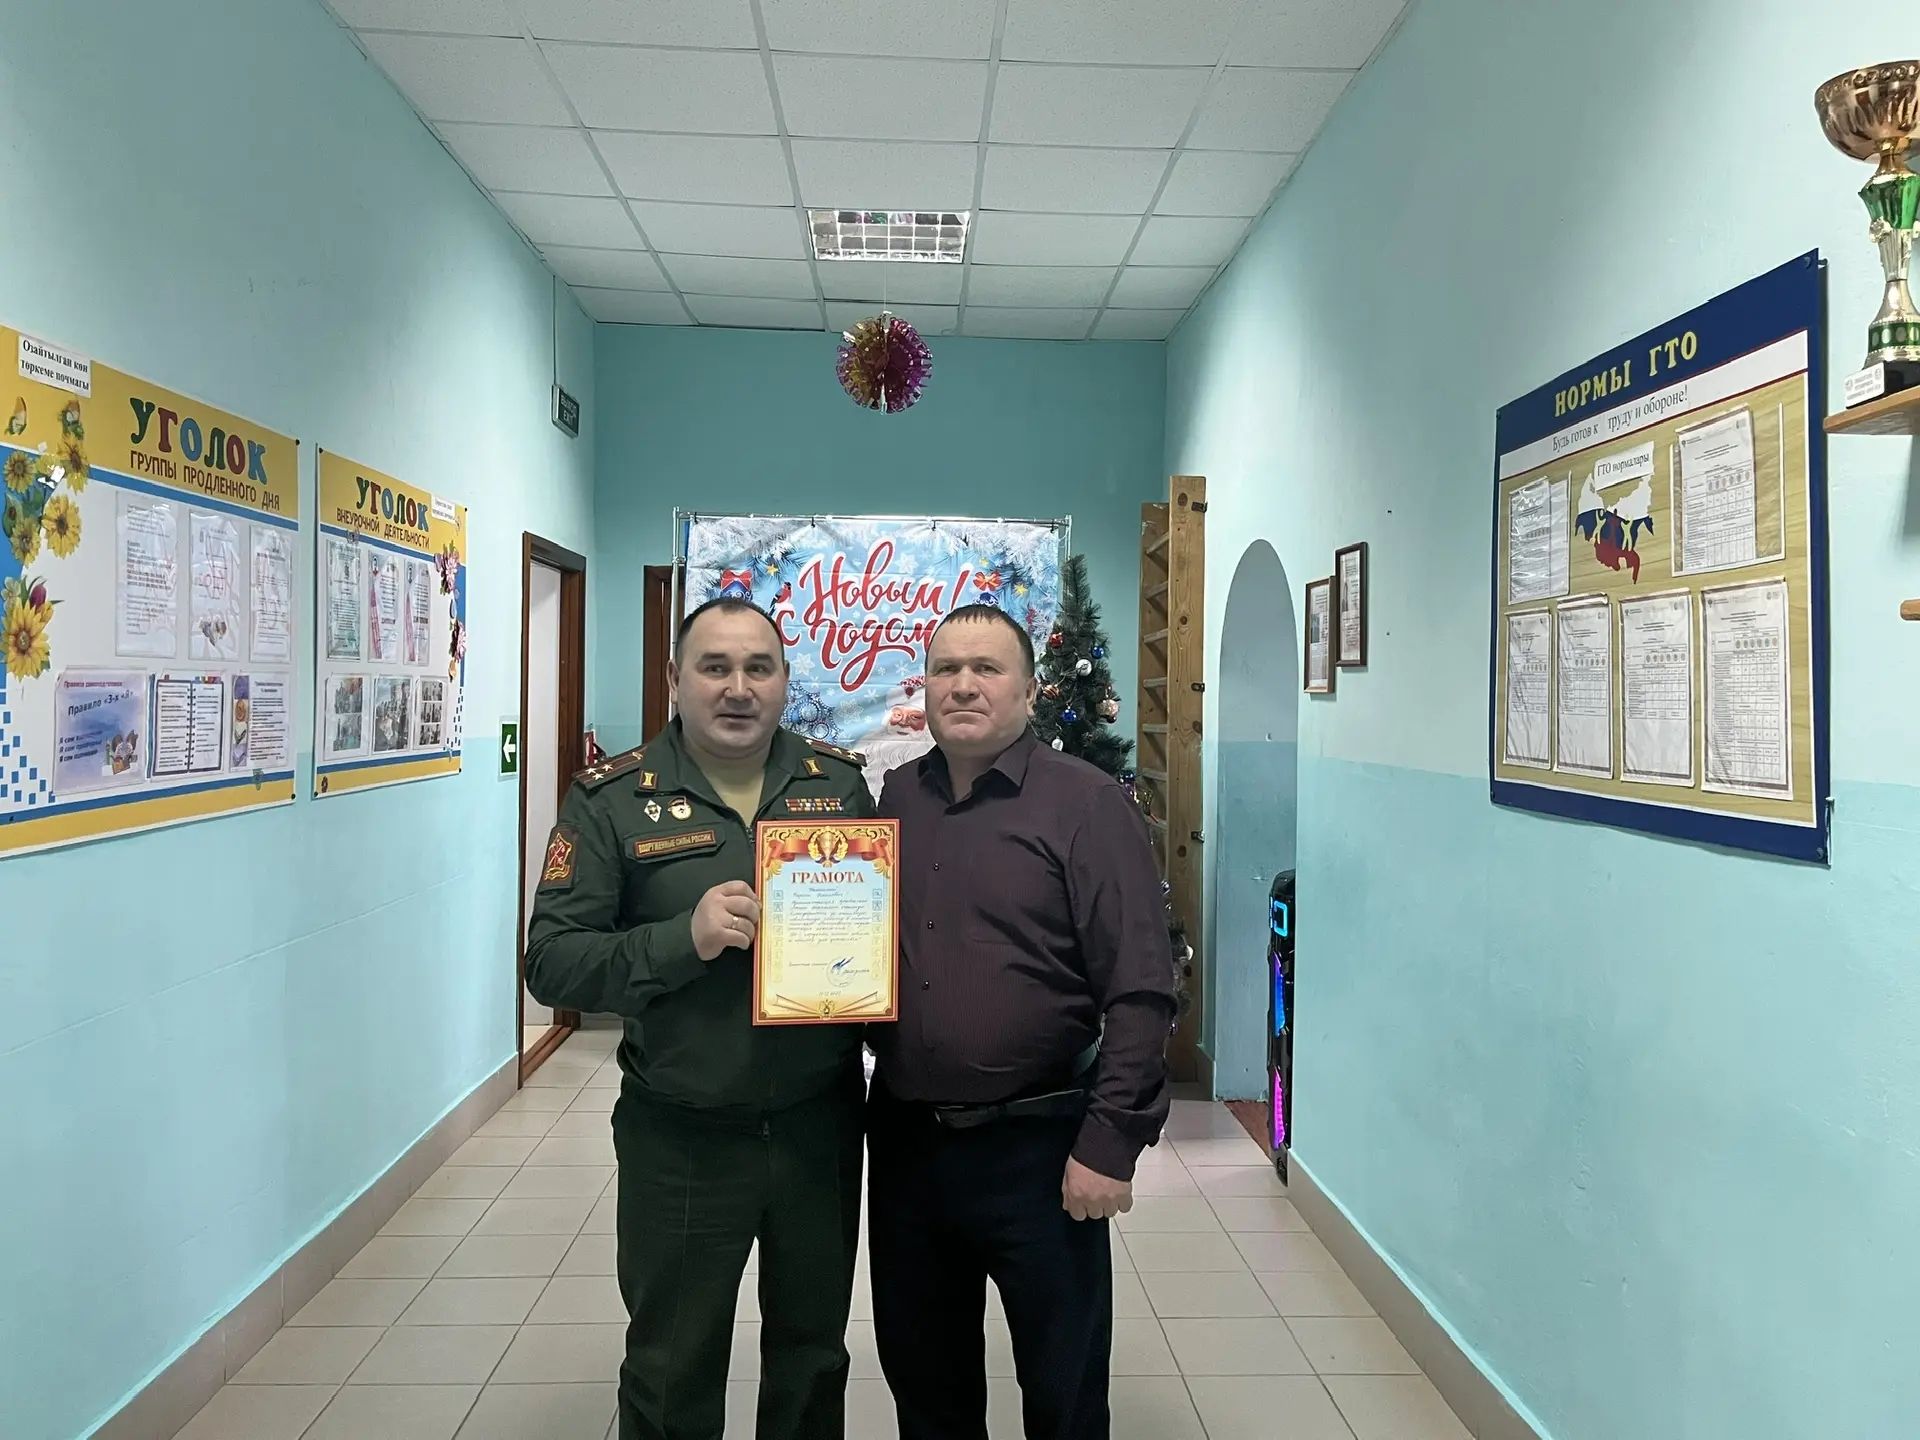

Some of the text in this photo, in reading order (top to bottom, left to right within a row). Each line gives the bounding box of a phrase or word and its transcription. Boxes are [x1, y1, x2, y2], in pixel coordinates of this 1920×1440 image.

[1554, 331, 1697, 417] НОРМЫ ГТО
[130, 397, 268, 485] УГОЛОК
[1552, 384, 1688, 453] Будь готов к труду и обороне!
[130, 450, 280, 511] ГРУППЫ ПРОДЛЕННОГО ДНЯ
[1597, 453, 1650, 477] ГТО нормалары
[336, 507, 430, 550] ВНЕУРОЧНОЙ ДЕЯТЕЛЬНОСТИ
[356, 476, 429, 532] УГОЛОК
[68, 699, 102, 717] Правило
[791, 871, 865, 884] ГРАМОТА
